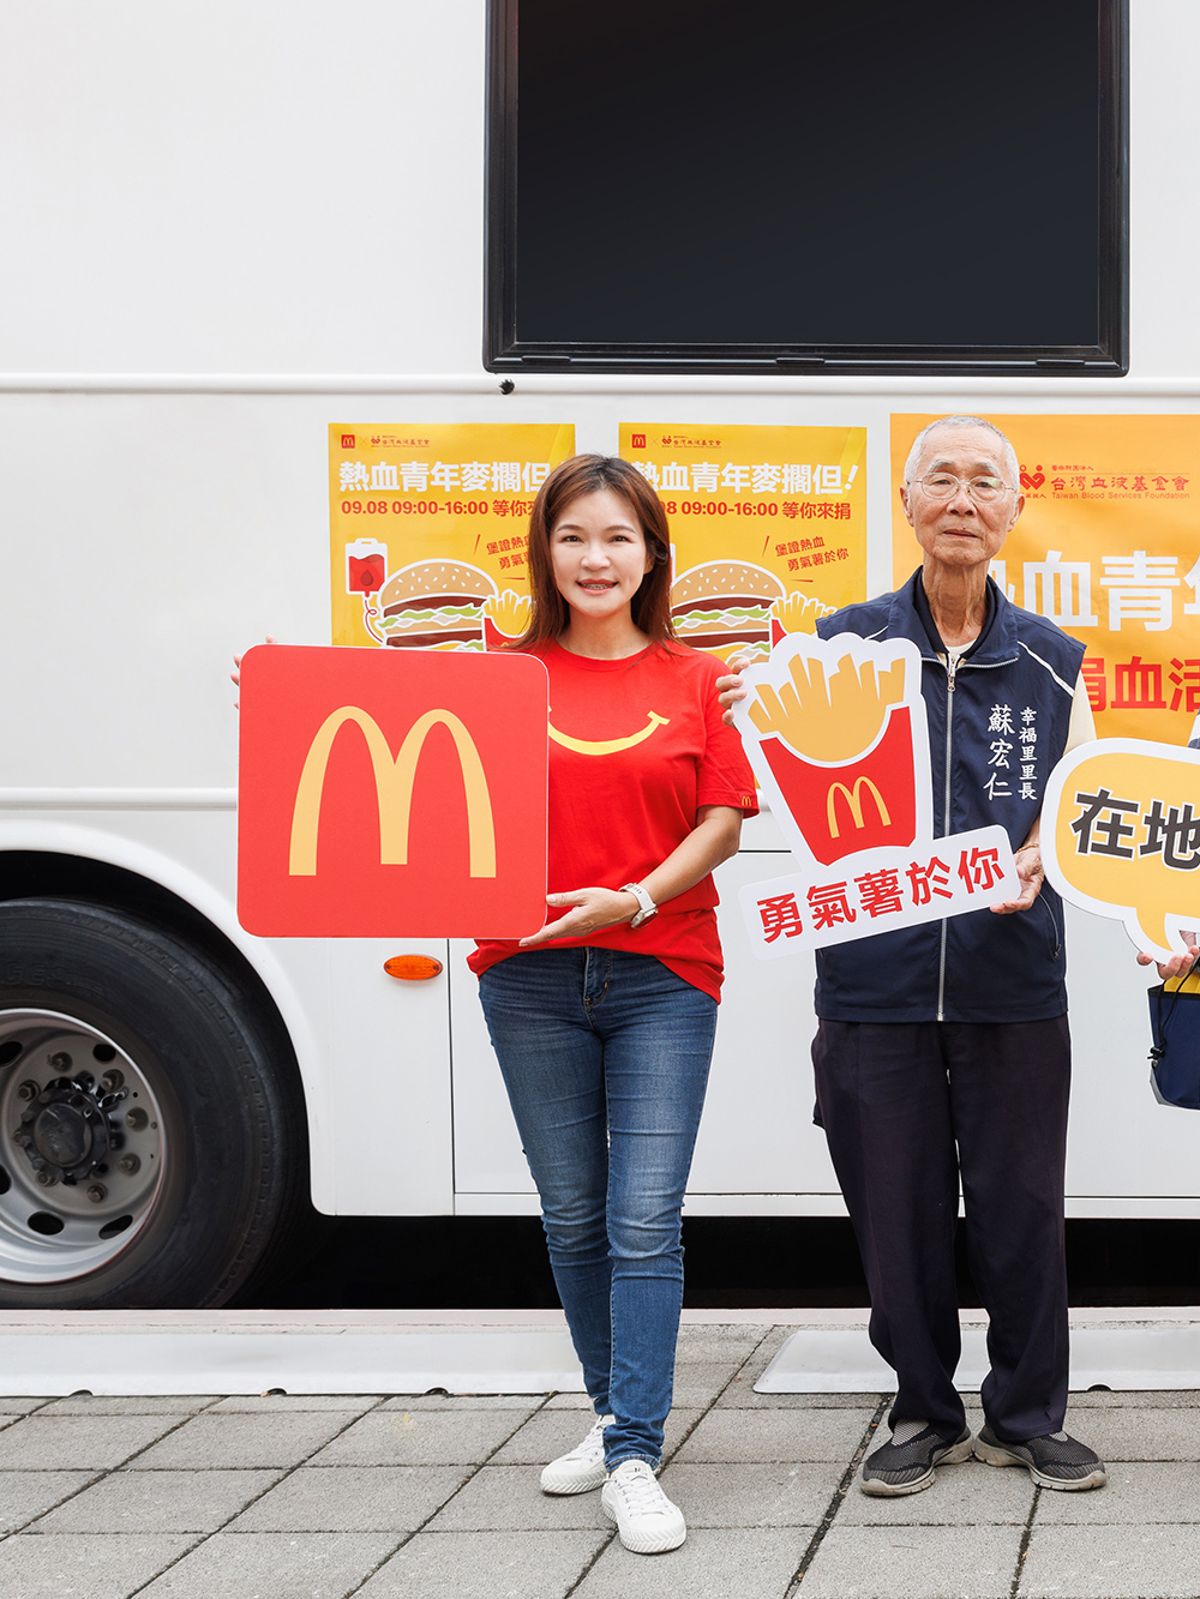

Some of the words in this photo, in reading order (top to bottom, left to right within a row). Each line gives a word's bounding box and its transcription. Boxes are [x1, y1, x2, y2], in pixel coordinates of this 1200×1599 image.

[1051, 475, 1190, 491] 台灣血液基金會
[1051, 491, 1079, 499] Taiwan
[1081, 491, 1105, 499] Blood
[1108, 491, 1142, 499] Services
[1145, 491, 1191, 499] Foundation
[341, 500, 388, 515] 09.08
[391, 500, 489, 515] 09:00-16:00
[681, 501, 779, 517] 09:00-16:00
[782, 501, 852, 520] 等你來捐
[787, 548, 849, 572] 勇氣薯於你
[983, 704, 1016, 800] 蘇宏仁
[1018, 706, 1038, 800] 幸福里里長
[757, 846, 1006, 944] 勇氣薯於你
